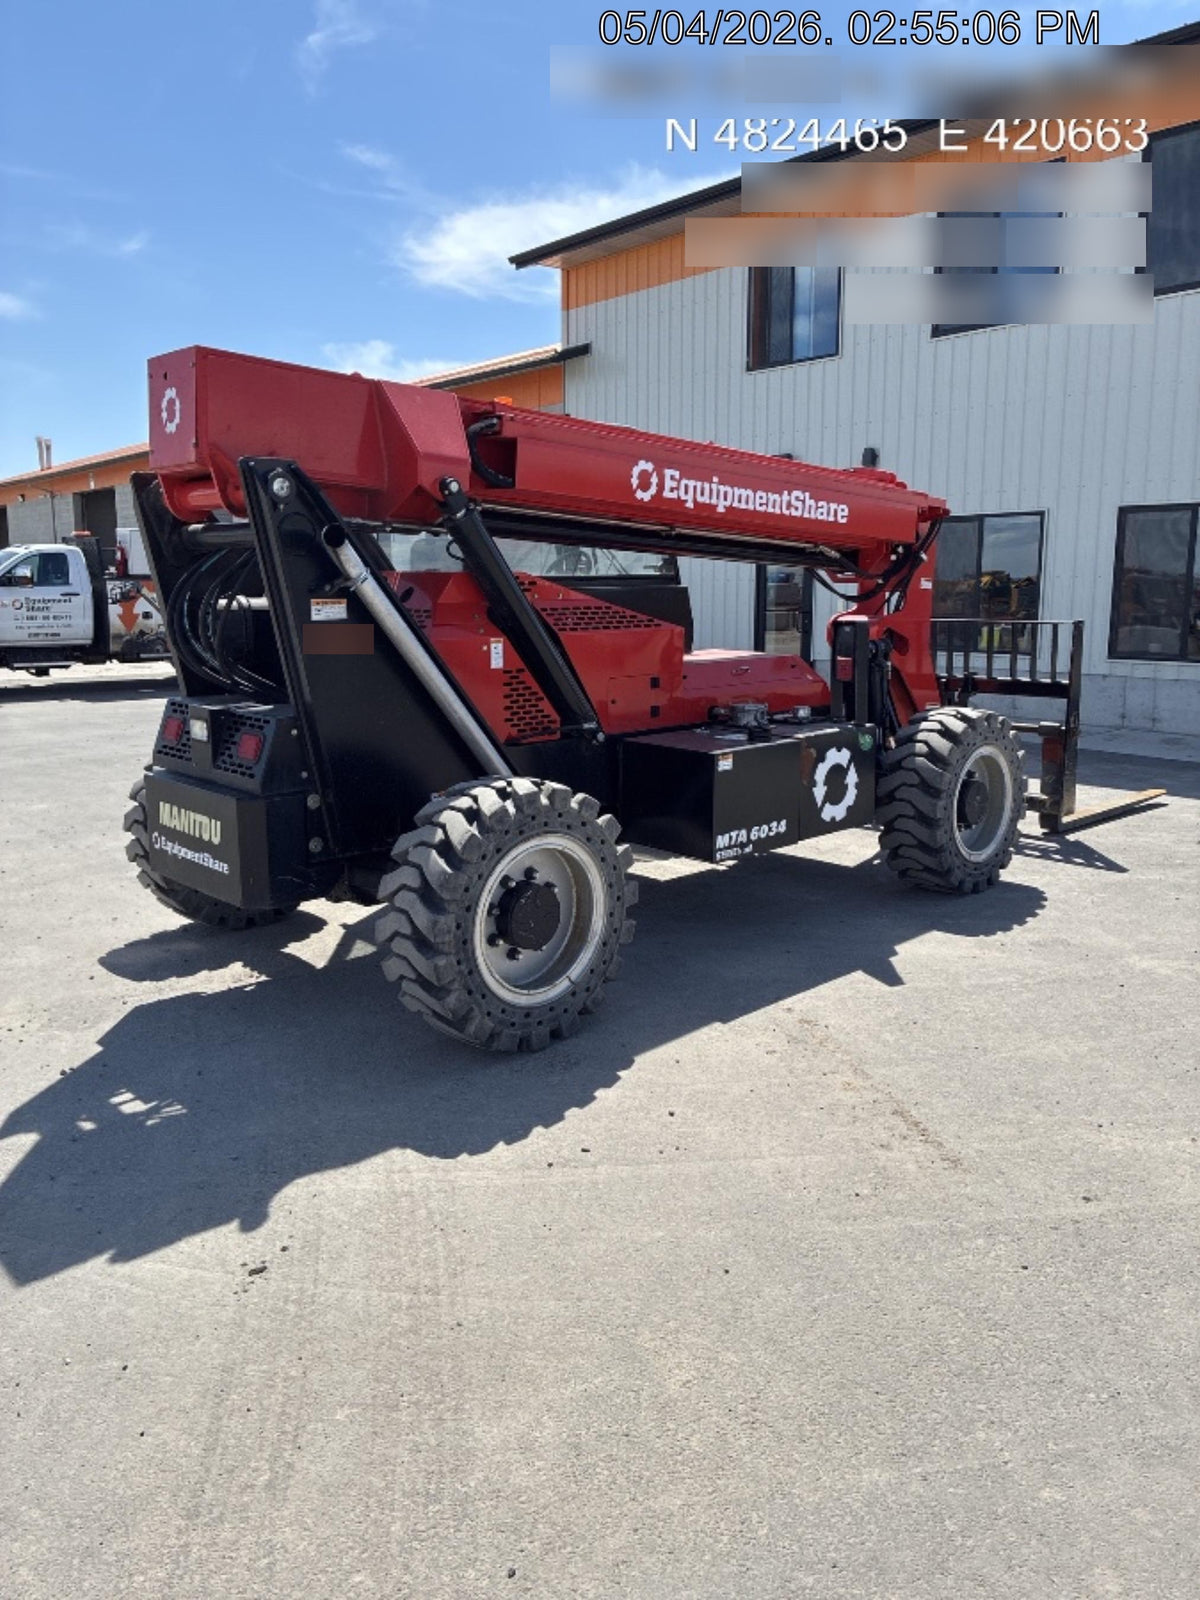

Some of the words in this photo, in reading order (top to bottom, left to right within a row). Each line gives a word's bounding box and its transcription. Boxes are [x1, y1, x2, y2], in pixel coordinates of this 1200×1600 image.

[662, 468, 849, 524] EquipmentShare
[159, 801, 222, 846] MANITOU
[716, 828, 748, 850] MTA
[750, 819, 788, 842] 6034
